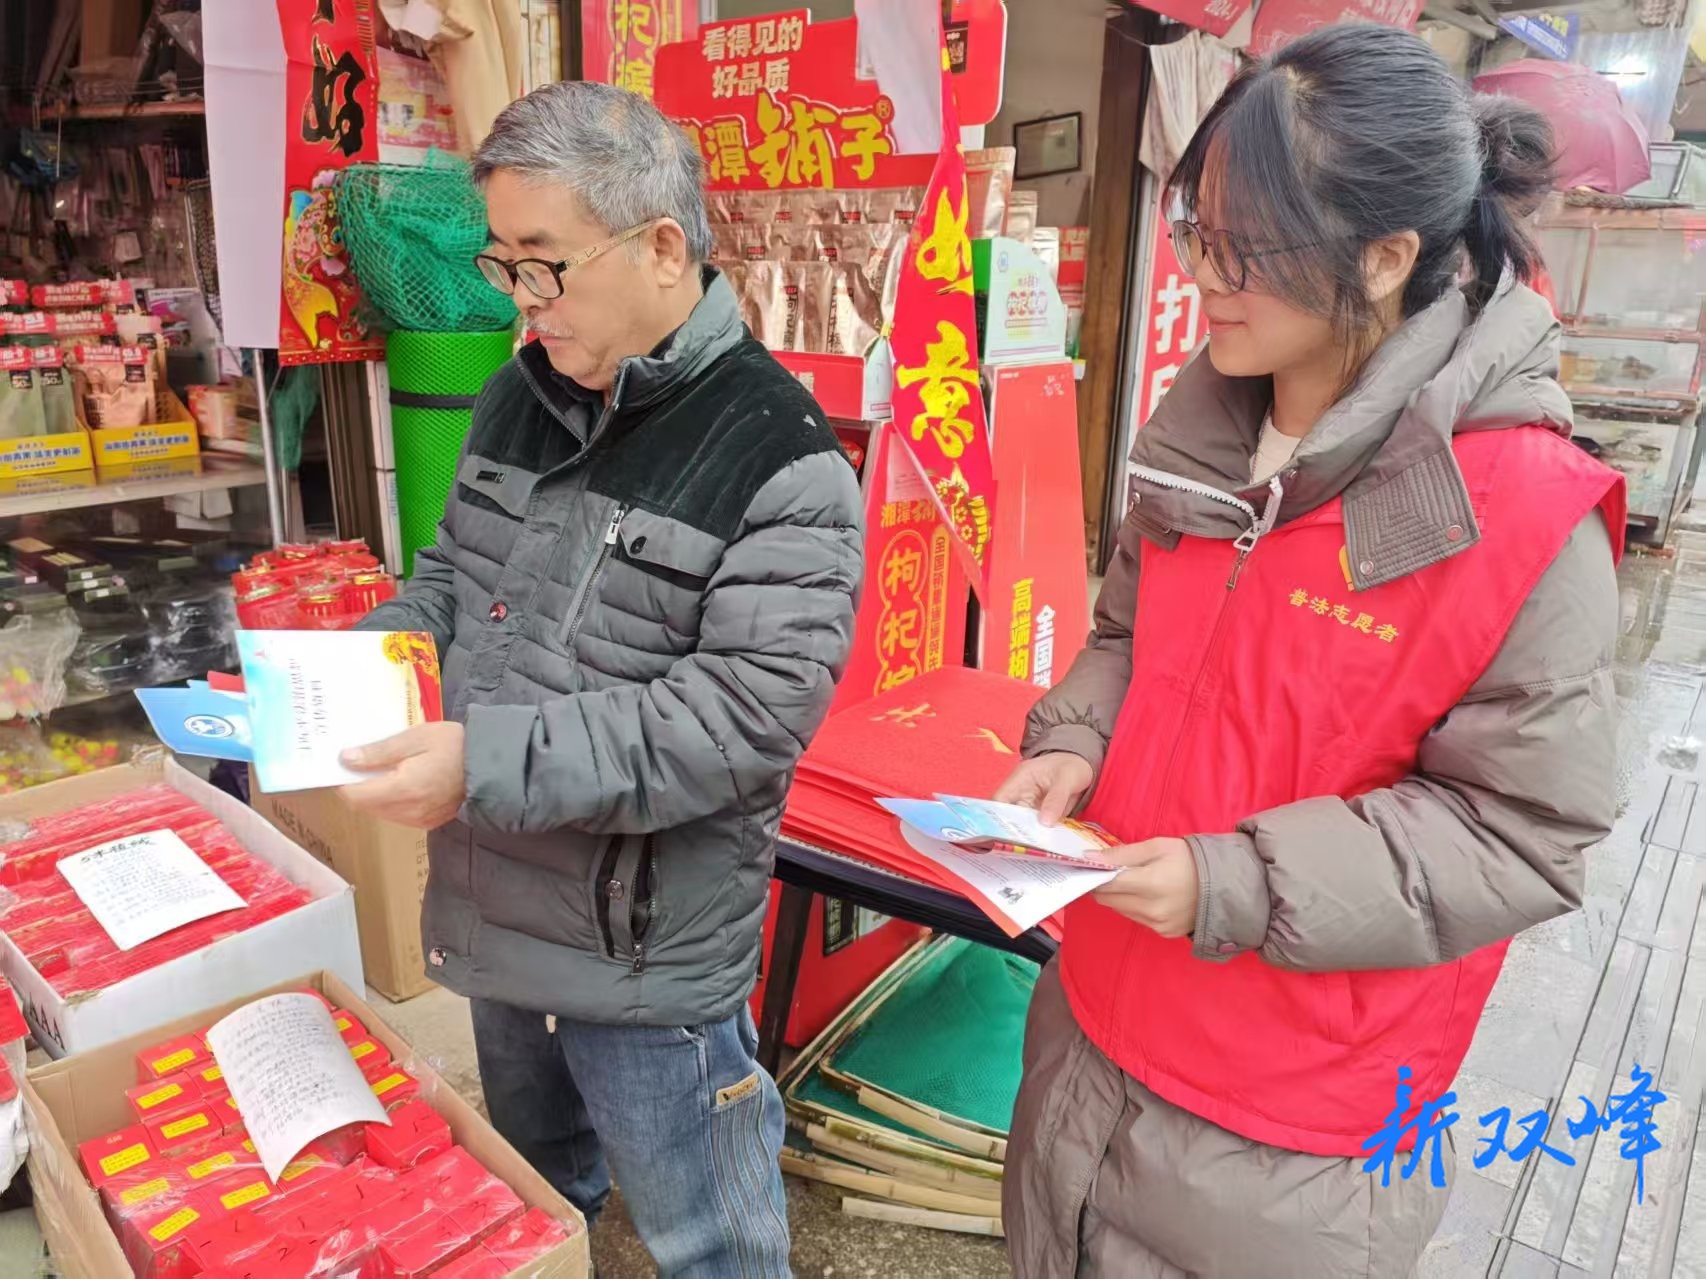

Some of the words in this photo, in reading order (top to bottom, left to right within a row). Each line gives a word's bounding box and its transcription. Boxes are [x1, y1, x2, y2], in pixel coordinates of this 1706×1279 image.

[702, 16, 804, 62] 看得见的
[712, 57, 790, 98] 好品质
[1288, 587, 1400, 644] 普法志愿者
